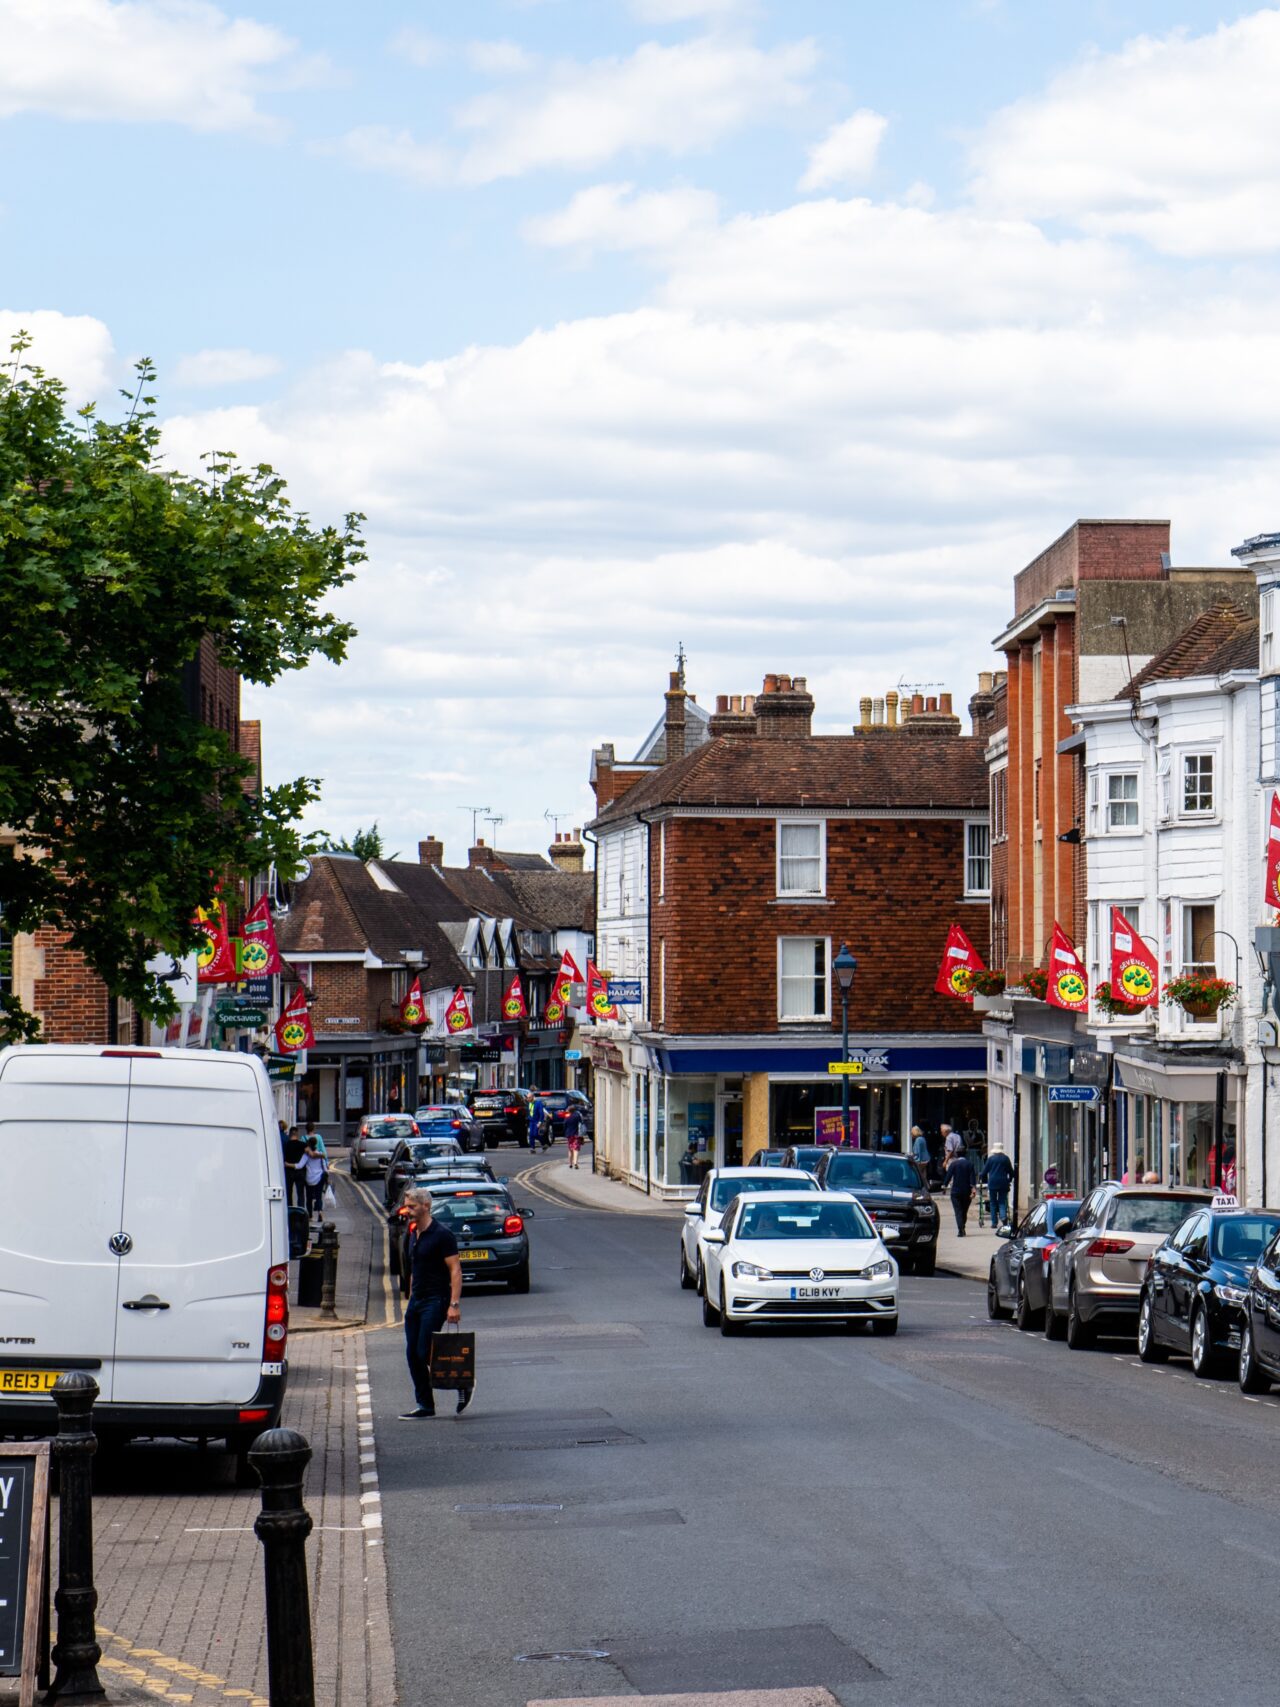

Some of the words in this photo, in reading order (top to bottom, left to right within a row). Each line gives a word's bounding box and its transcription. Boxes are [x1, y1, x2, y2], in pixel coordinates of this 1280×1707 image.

[608, 989, 641, 997] HALIFAX
[218, 1012, 262, 1023] Specsavers
[268, 1064, 294, 1075] SUBWAY
[1216, 1196, 1235, 1206] TAXI
[798, 1288, 820, 1297] GL18
[822, 1288, 840, 1297] KVY
[3, 1373, 40, 1388] RE13
